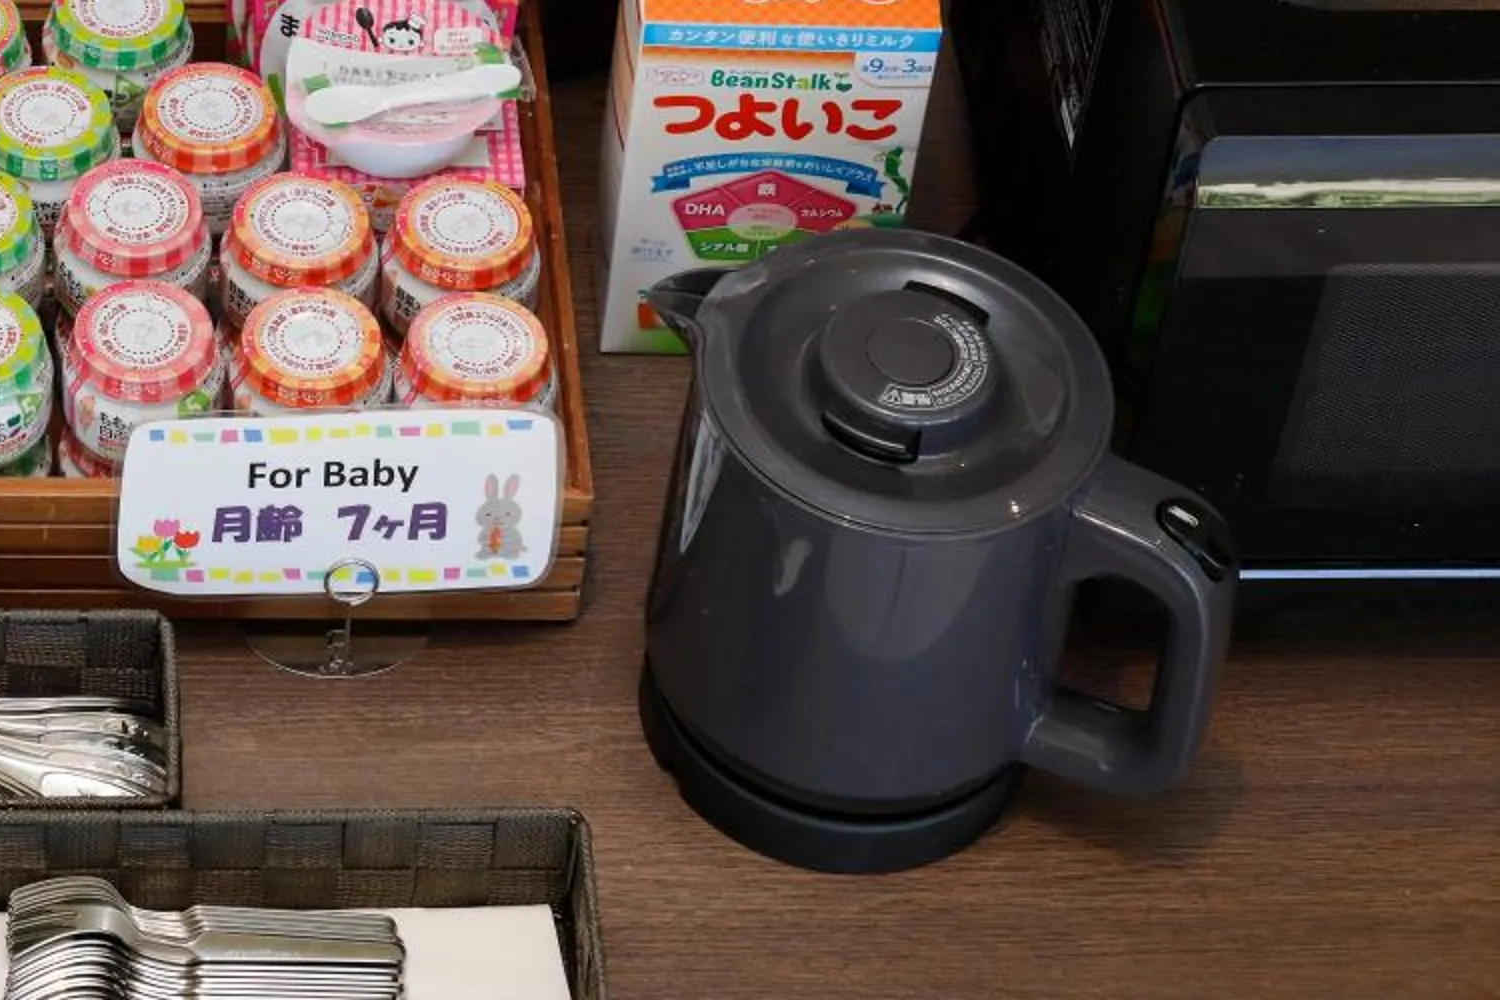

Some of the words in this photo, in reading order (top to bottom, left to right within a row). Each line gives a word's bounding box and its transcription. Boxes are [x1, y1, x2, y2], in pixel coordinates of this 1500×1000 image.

[711, 69, 831, 93] BeanStalk
[653, 93, 903, 141] つよいこ
[684, 202, 725, 217] DHA
[247, 461, 310, 489] For
[323, 459, 419, 493] Baby
[212, 504, 303, 543] 月齢
